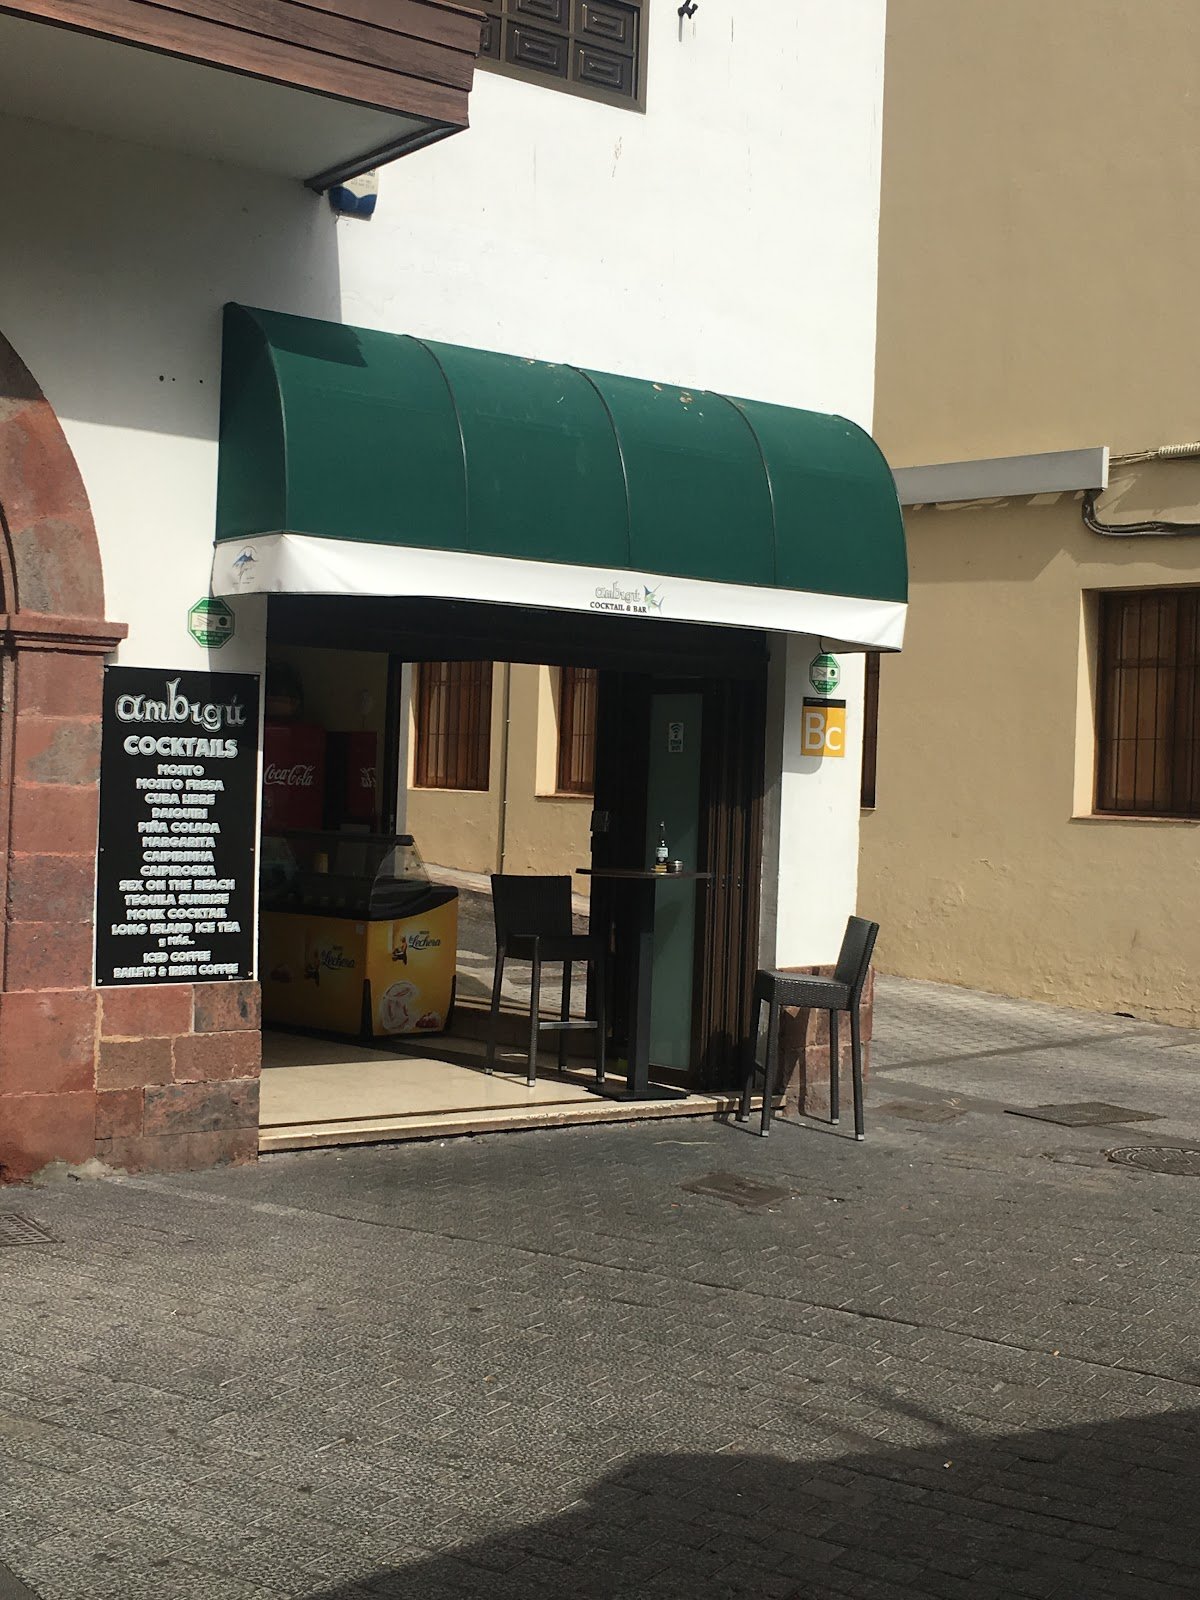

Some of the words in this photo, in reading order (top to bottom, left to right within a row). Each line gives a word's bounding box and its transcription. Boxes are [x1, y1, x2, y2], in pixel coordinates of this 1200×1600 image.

[590, 601, 624, 611] COCKTAIL
[633, 605, 647, 613] BAR
[124, 735, 238, 758] COCKTAILS
[157, 764, 204, 776] MOJITO
[136, 778, 184, 790] MOJITO
[185, 779, 225, 791] FRESA
[144, 793, 180, 805] CUBA
[182, 794, 215, 805] LIBRE
[152, 807, 208, 819] DAIQUIRI
[138, 820, 169, 833] PIÑA
[170, 822, 221, 833] COLADA
[142, 836, 216, 848] MARGARITA
[142, 851, 214, 862] CAIPIRINHA
[140, 865, 216, 876] CAIPIROSKA
[119, 880, 144, 891] SEX
[146, 880, 166, 891] ON
[168, 879, 192, 891] THE
[194, 879, 235, 890] BEACH
[124, 894, 176, 906] TEQUILA
[178, 893, 230, 905] SUNRISE
[126, 908, 166, 920] MONK
[167, 908, 227, 919] COCKTAIL
[111, 923, 148, 935] LONG
[150, 922, 193, 934] ISLAND
[195, 922, 216, 934] ICE
[217, 921, 241, 933] TEA
[143, 952, 169, 963] ICED
[170, 951, 211, 962] COFFEE
[113, 966, 156, 978] BAILEYS
[158, 966, 167, 977] &
[168, 965, 197, 976] IRISH
[199, 963, 239, 975] COFFEE
